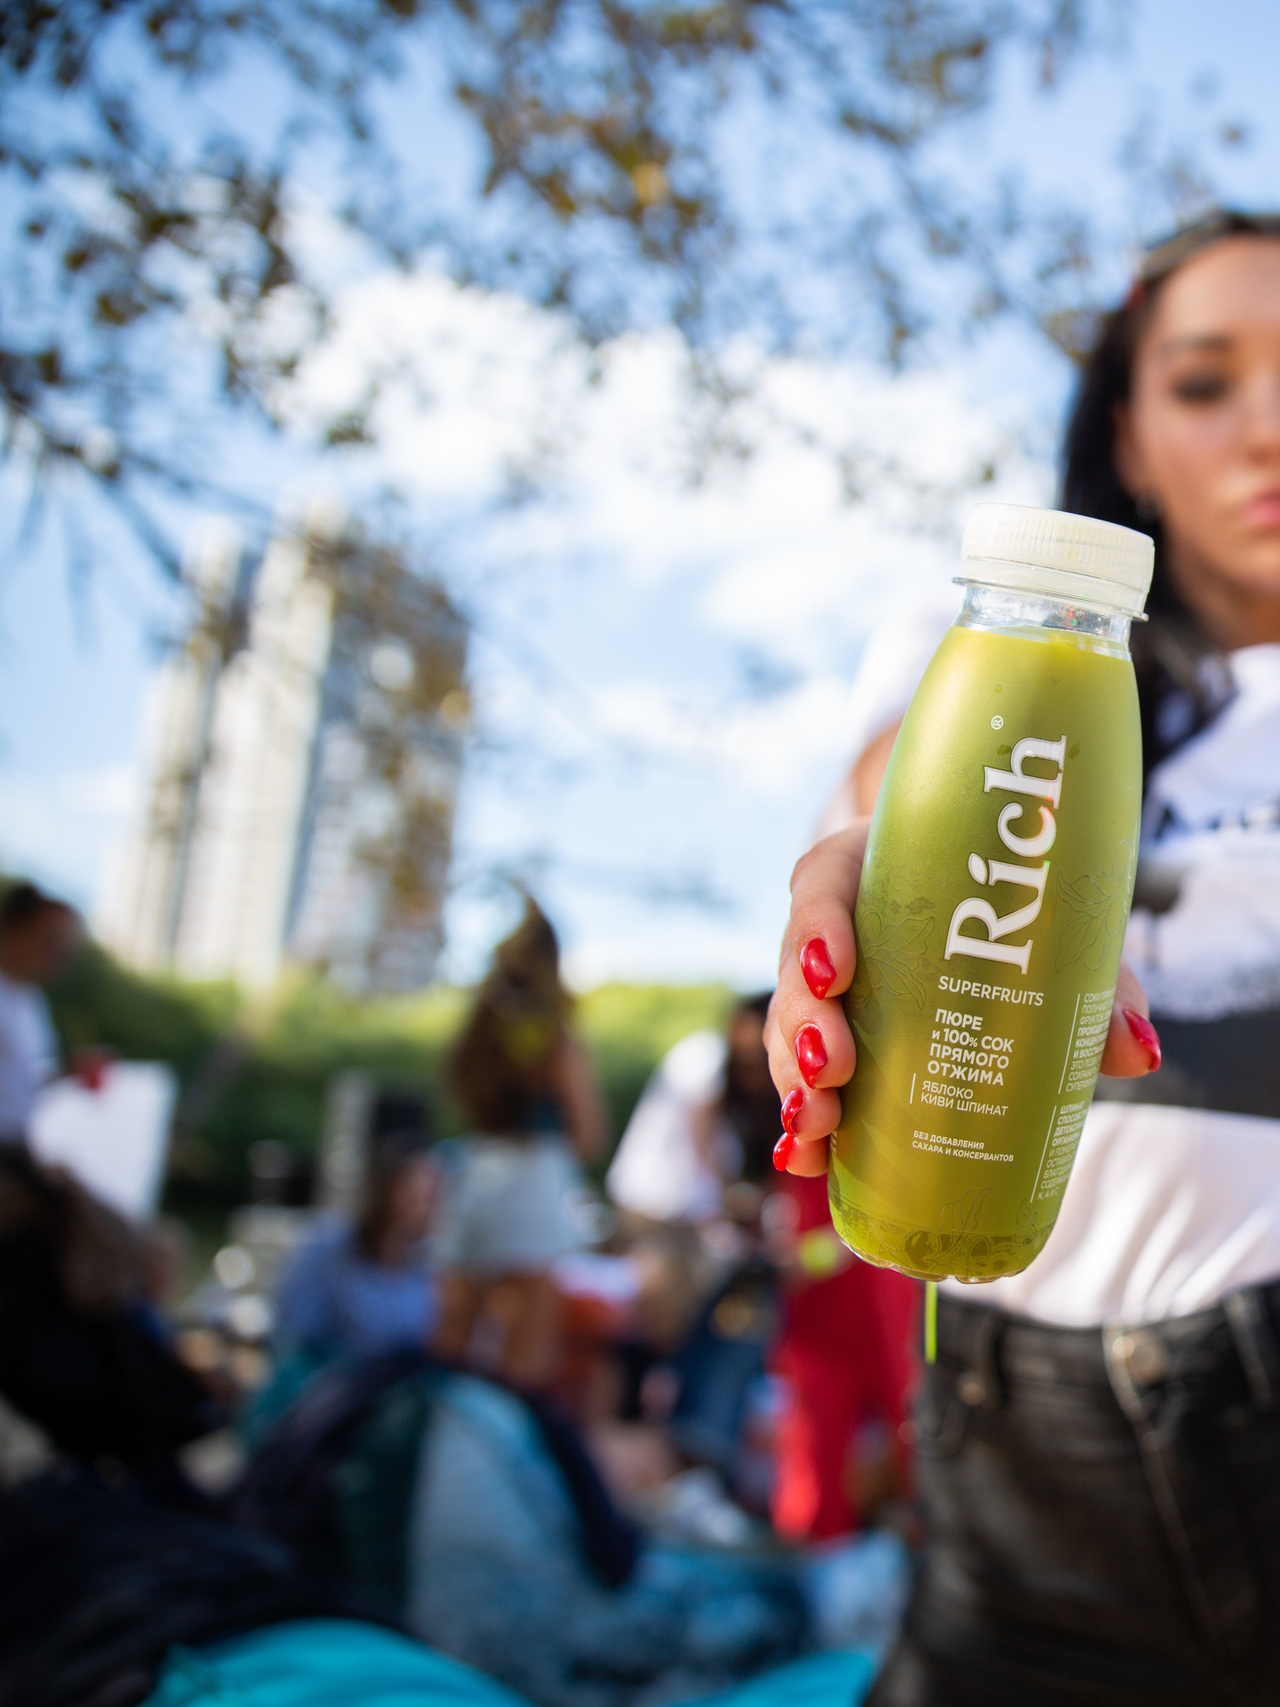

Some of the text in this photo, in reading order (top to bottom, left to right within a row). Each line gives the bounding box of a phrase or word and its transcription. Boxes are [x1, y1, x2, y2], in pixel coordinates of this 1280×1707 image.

[944, 735, 1067, 975] Rich
[937, 975, 1045, 1006] SUPERFRUITS
[934, 1008, 984, 1031] ПЮРЕ
[943, 1028, 978, 1048] 100%
[981, 1035, 1015, 1053] СОК
[929, 1042, 1010, 1070] ПРЯМОГО
[927, 1060, 1004, 1086] ОТЖИМА
[922, 1080, 974, 1100] ЯБЛОКО
[920, 1092, 1009, 1117] КИВИ ШПИНАТ
[912, 1140, 1015, 1162] САХАРА И КОНСЕРВАНТОВ
[913, 1130, 985, 1150] БЕЗ ДОБАВЛЕНИЯ
